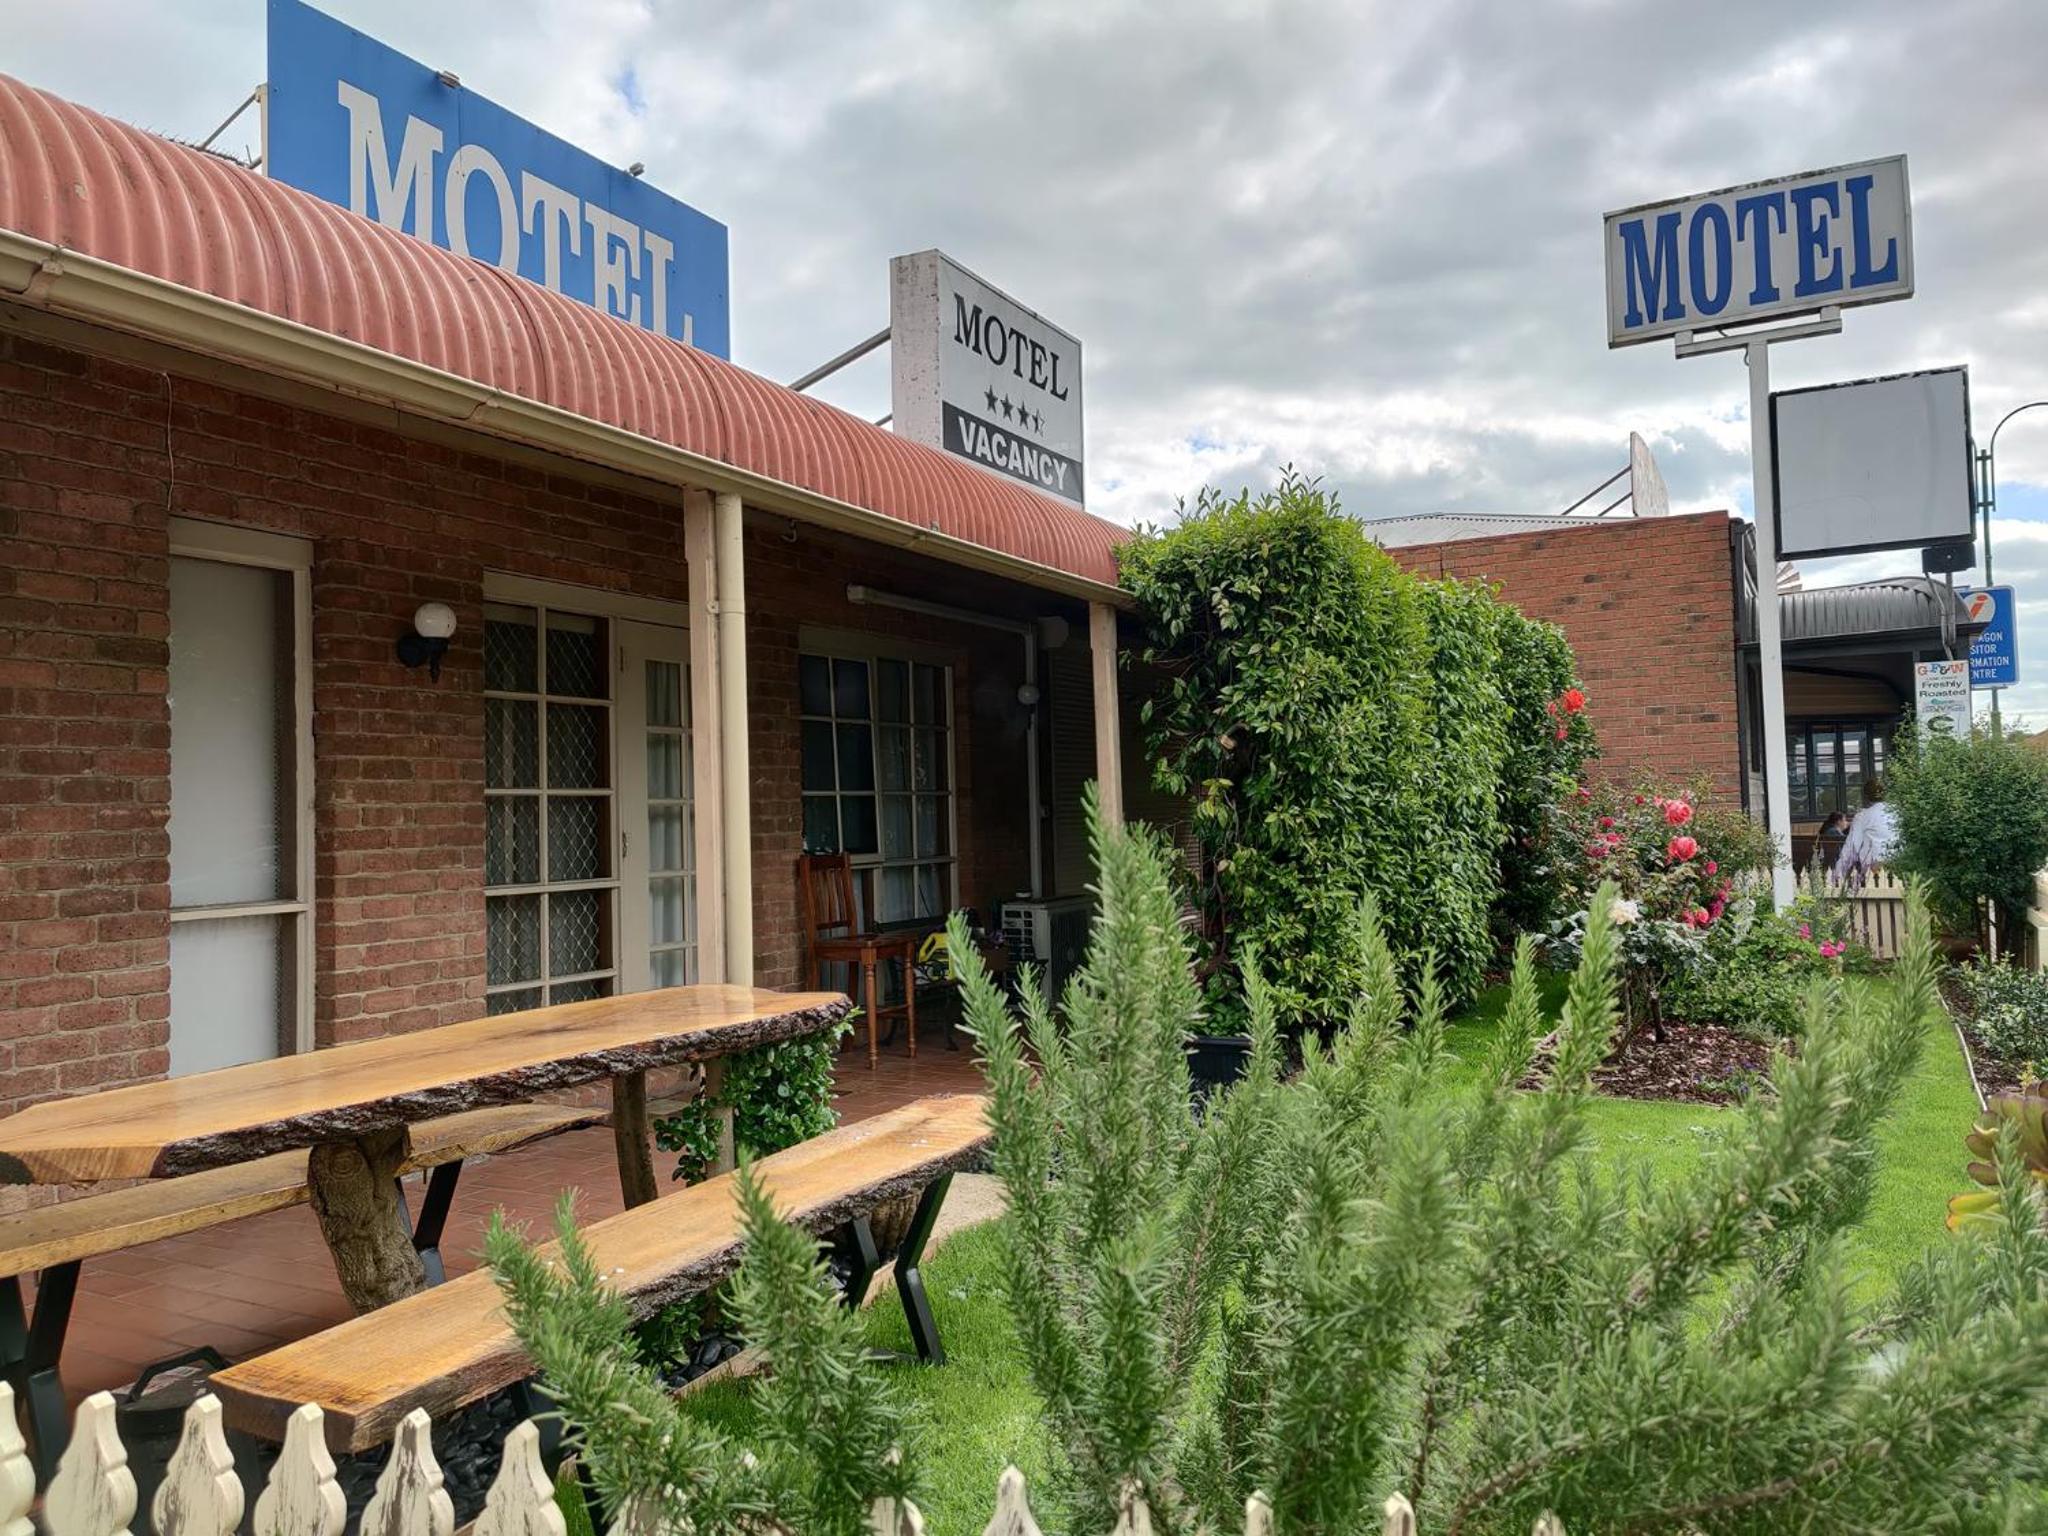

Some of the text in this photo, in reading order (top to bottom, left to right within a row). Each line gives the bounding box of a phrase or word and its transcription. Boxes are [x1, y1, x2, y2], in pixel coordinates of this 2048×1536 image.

[338, 80, 693, 347] MOTEL
[1619, 174, 1898, 328] MOTEL
[954, 293, 1068, 401] MOTEL
[958, 416, 1068, 491] VACANCY
[1977, 631, 2004, 643] AGON
[1969, 643, 1998, 655] SITOR
[1969, 656, 2010, 668] RMATION
[1971, 668, 1999, 680] NTRE
[1921, 680, 1963, 689] Freshly
[1919, 688, 1967, 697] Roasted
